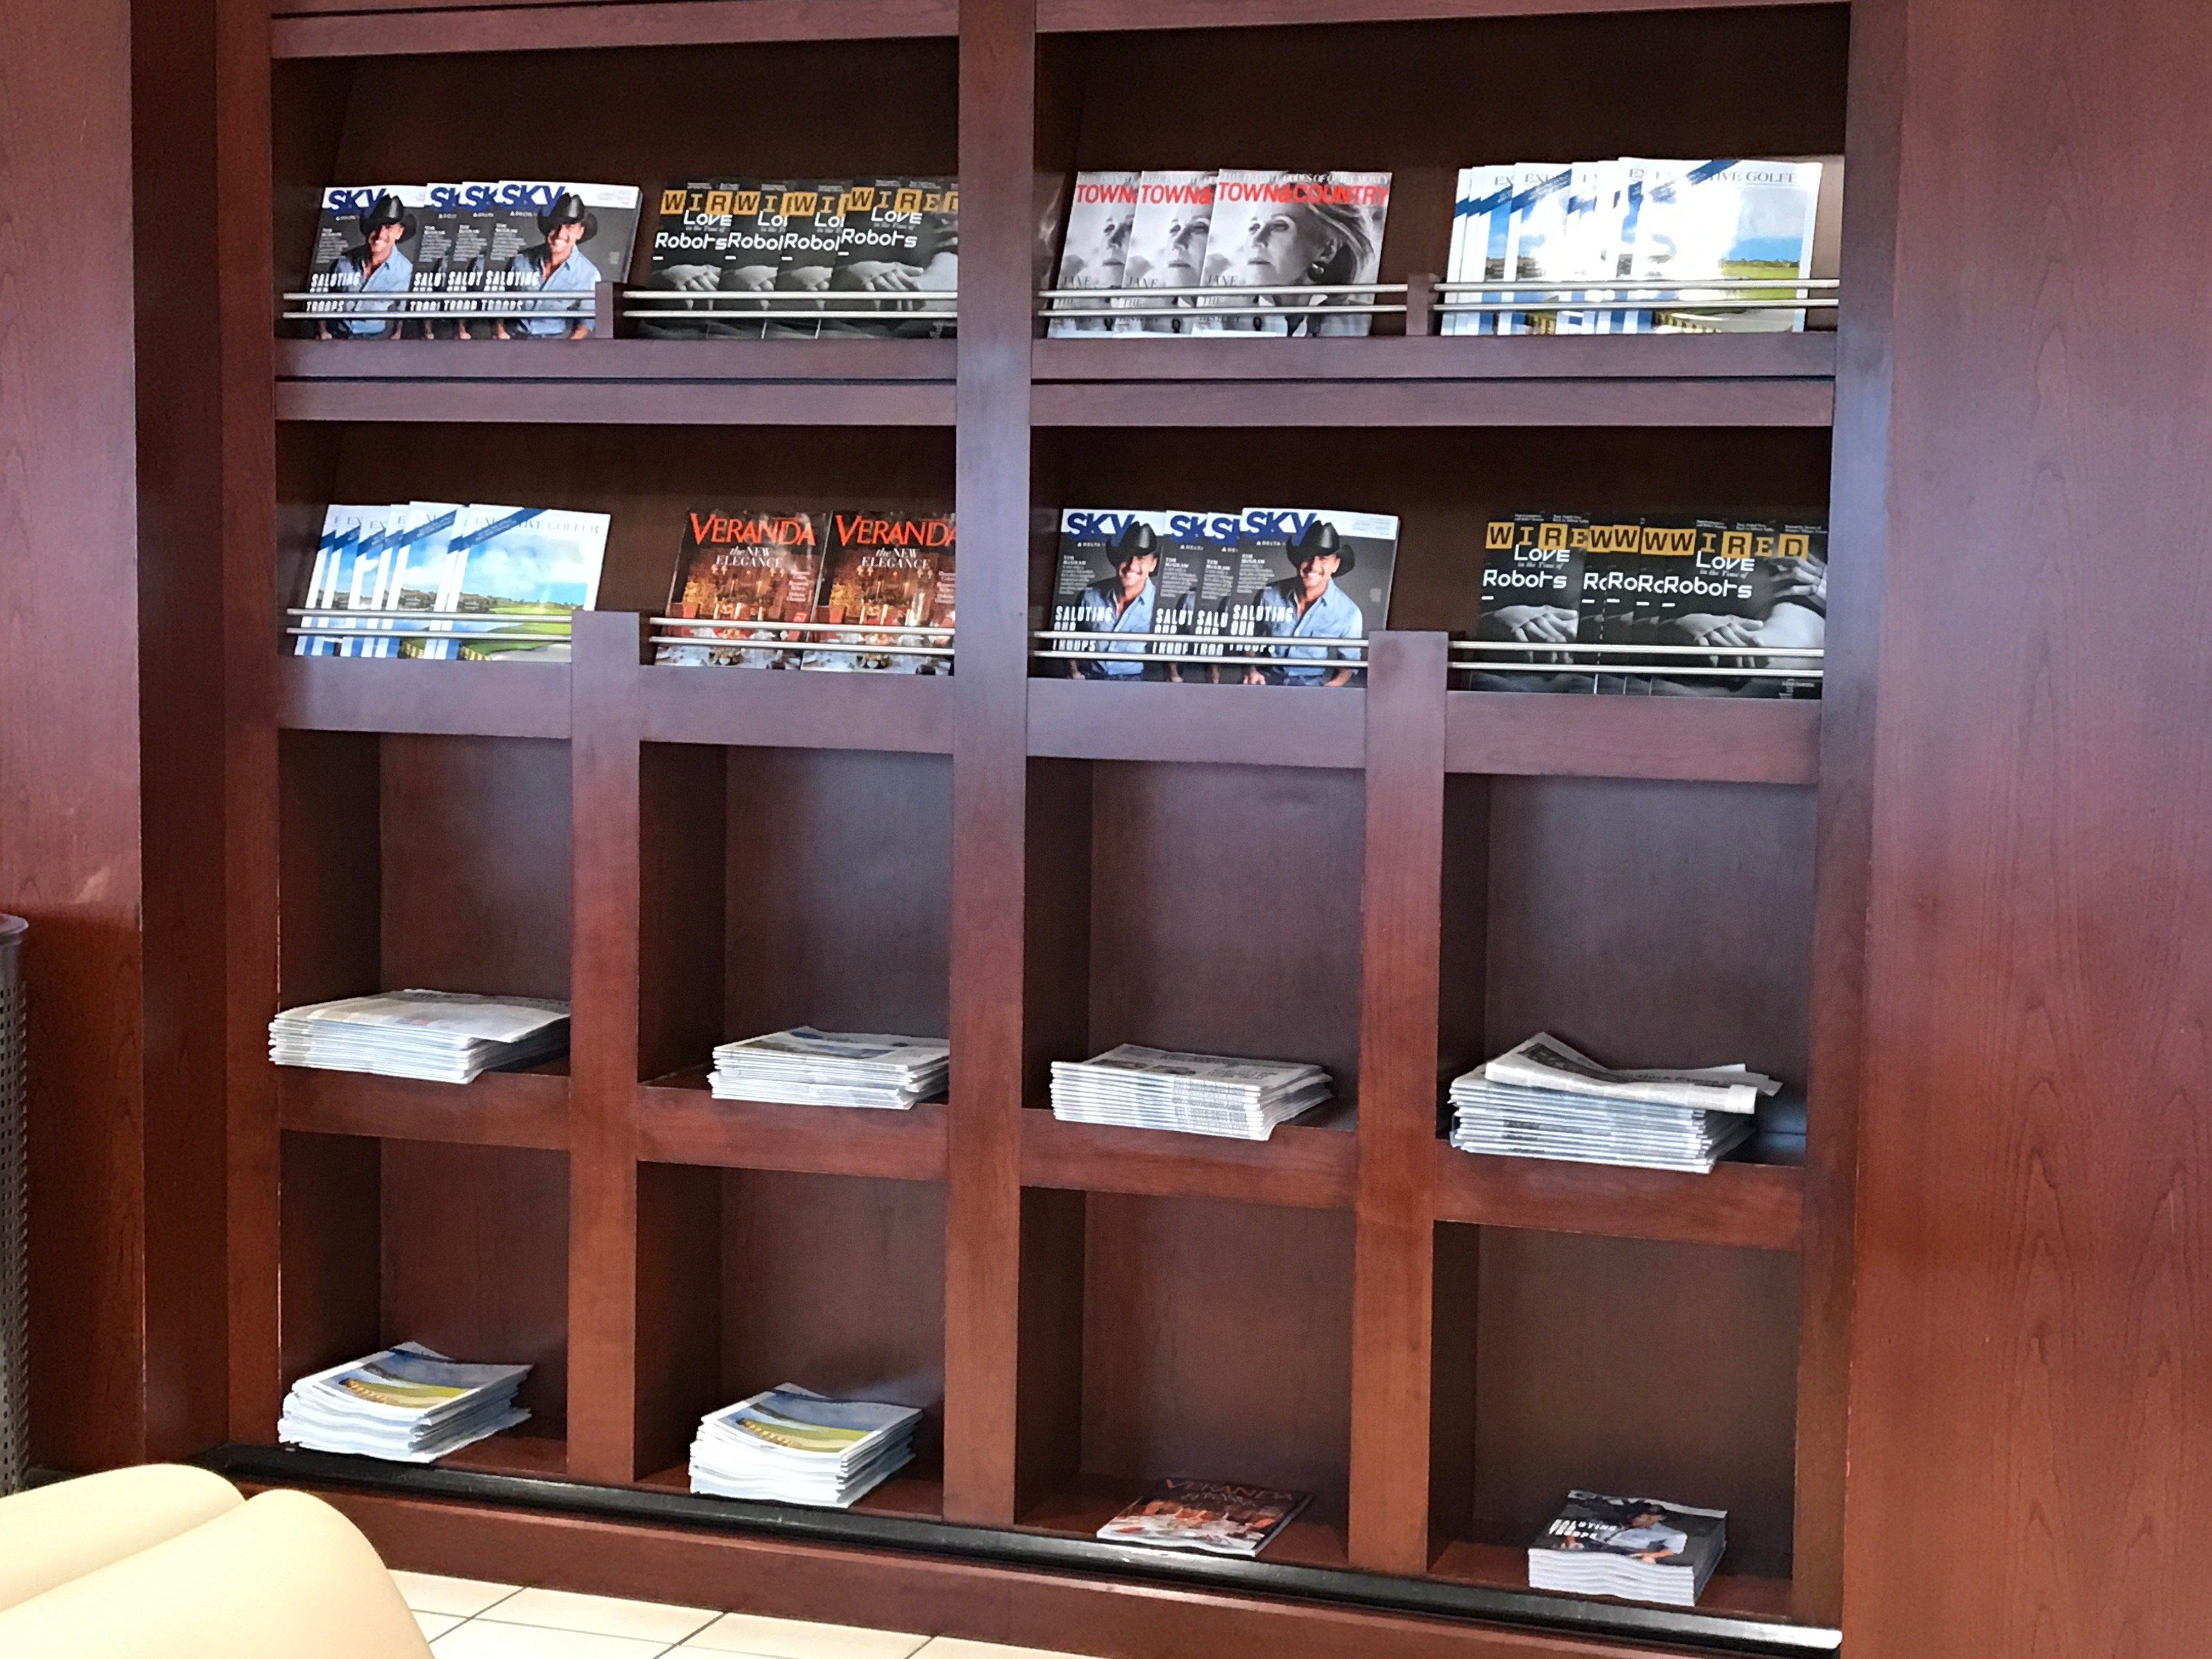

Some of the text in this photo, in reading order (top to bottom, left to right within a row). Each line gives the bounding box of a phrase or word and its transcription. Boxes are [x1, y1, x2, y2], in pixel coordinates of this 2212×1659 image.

[329, 188, 386, 216] SKY
[501, 184, 566, 216] SKY
[311, 272, 361, 287] SALUTING
[485, 270, 541, 286] SALUTING
[690, 512, 816, 546] VERANDA
[1067, 512, 1136, 547] SKY
[1244, 511, 1317, 546] SKY
[1669, 528, 1809, 561] WIRED
[716, 555, 783, 567] ELEGANCE
[861, 556, 931, 569] ELEGANCE
[1056, 606, 1113, 622] SALUTING
[1233, 604, 1294, 623] SALUTING
[1230, 620, 1255, 636] OUR
